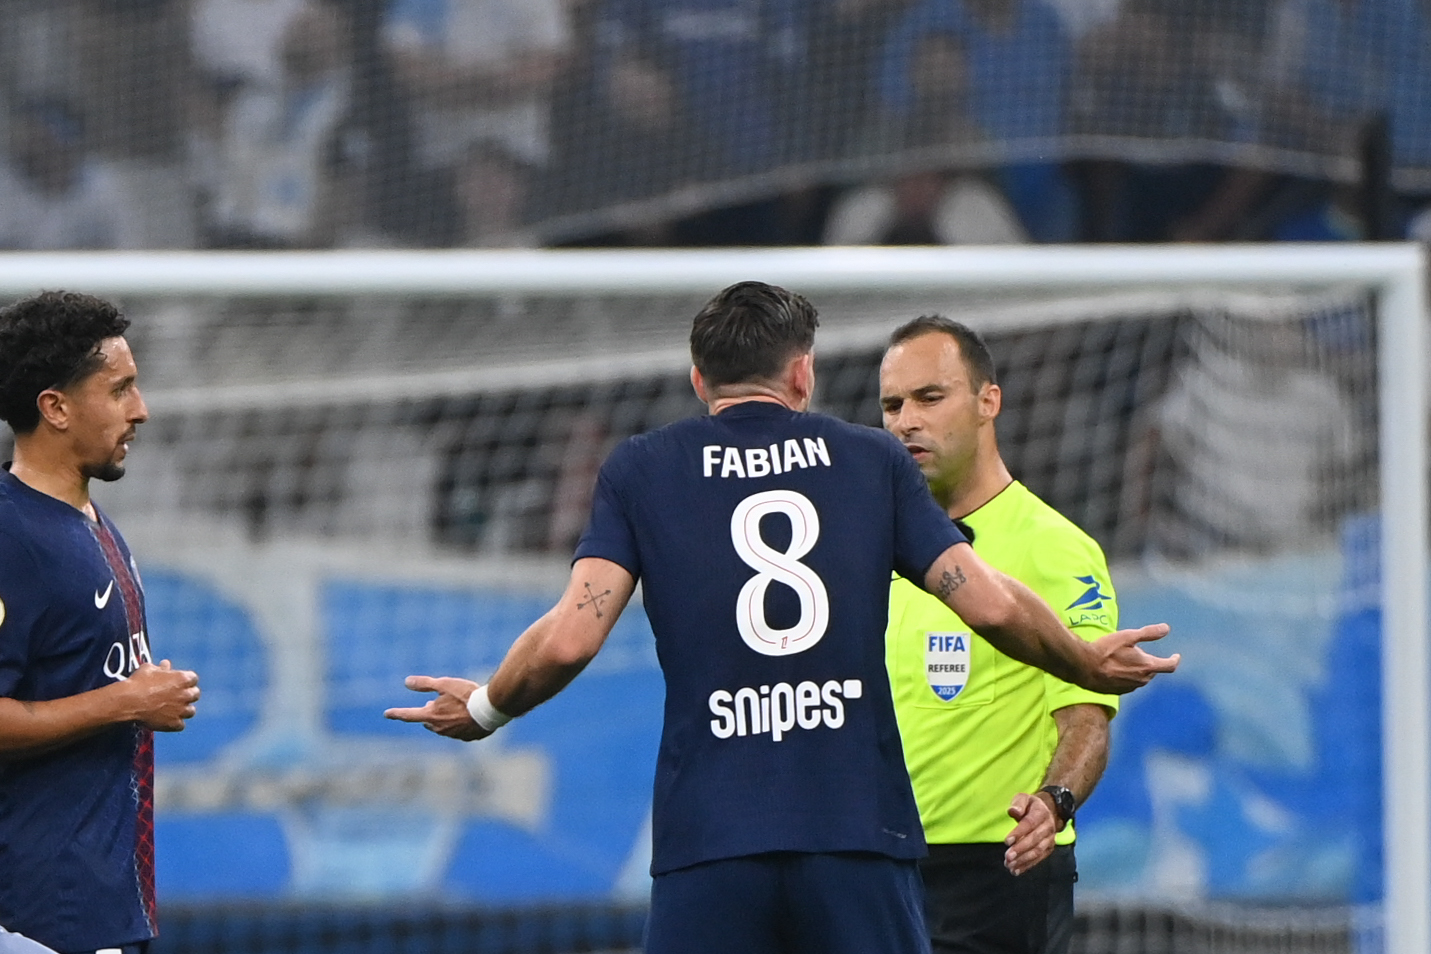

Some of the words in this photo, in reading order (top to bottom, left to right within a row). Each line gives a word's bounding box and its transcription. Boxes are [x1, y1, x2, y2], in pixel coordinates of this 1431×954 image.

[702, 437, 832, 479] FABIAN
[730, 489, 830, 657] 8
[928, 635, 966, 653] FIFA
[928, 664, 966, 673] REFEREE
[937, 686, 956, 696] 2025
